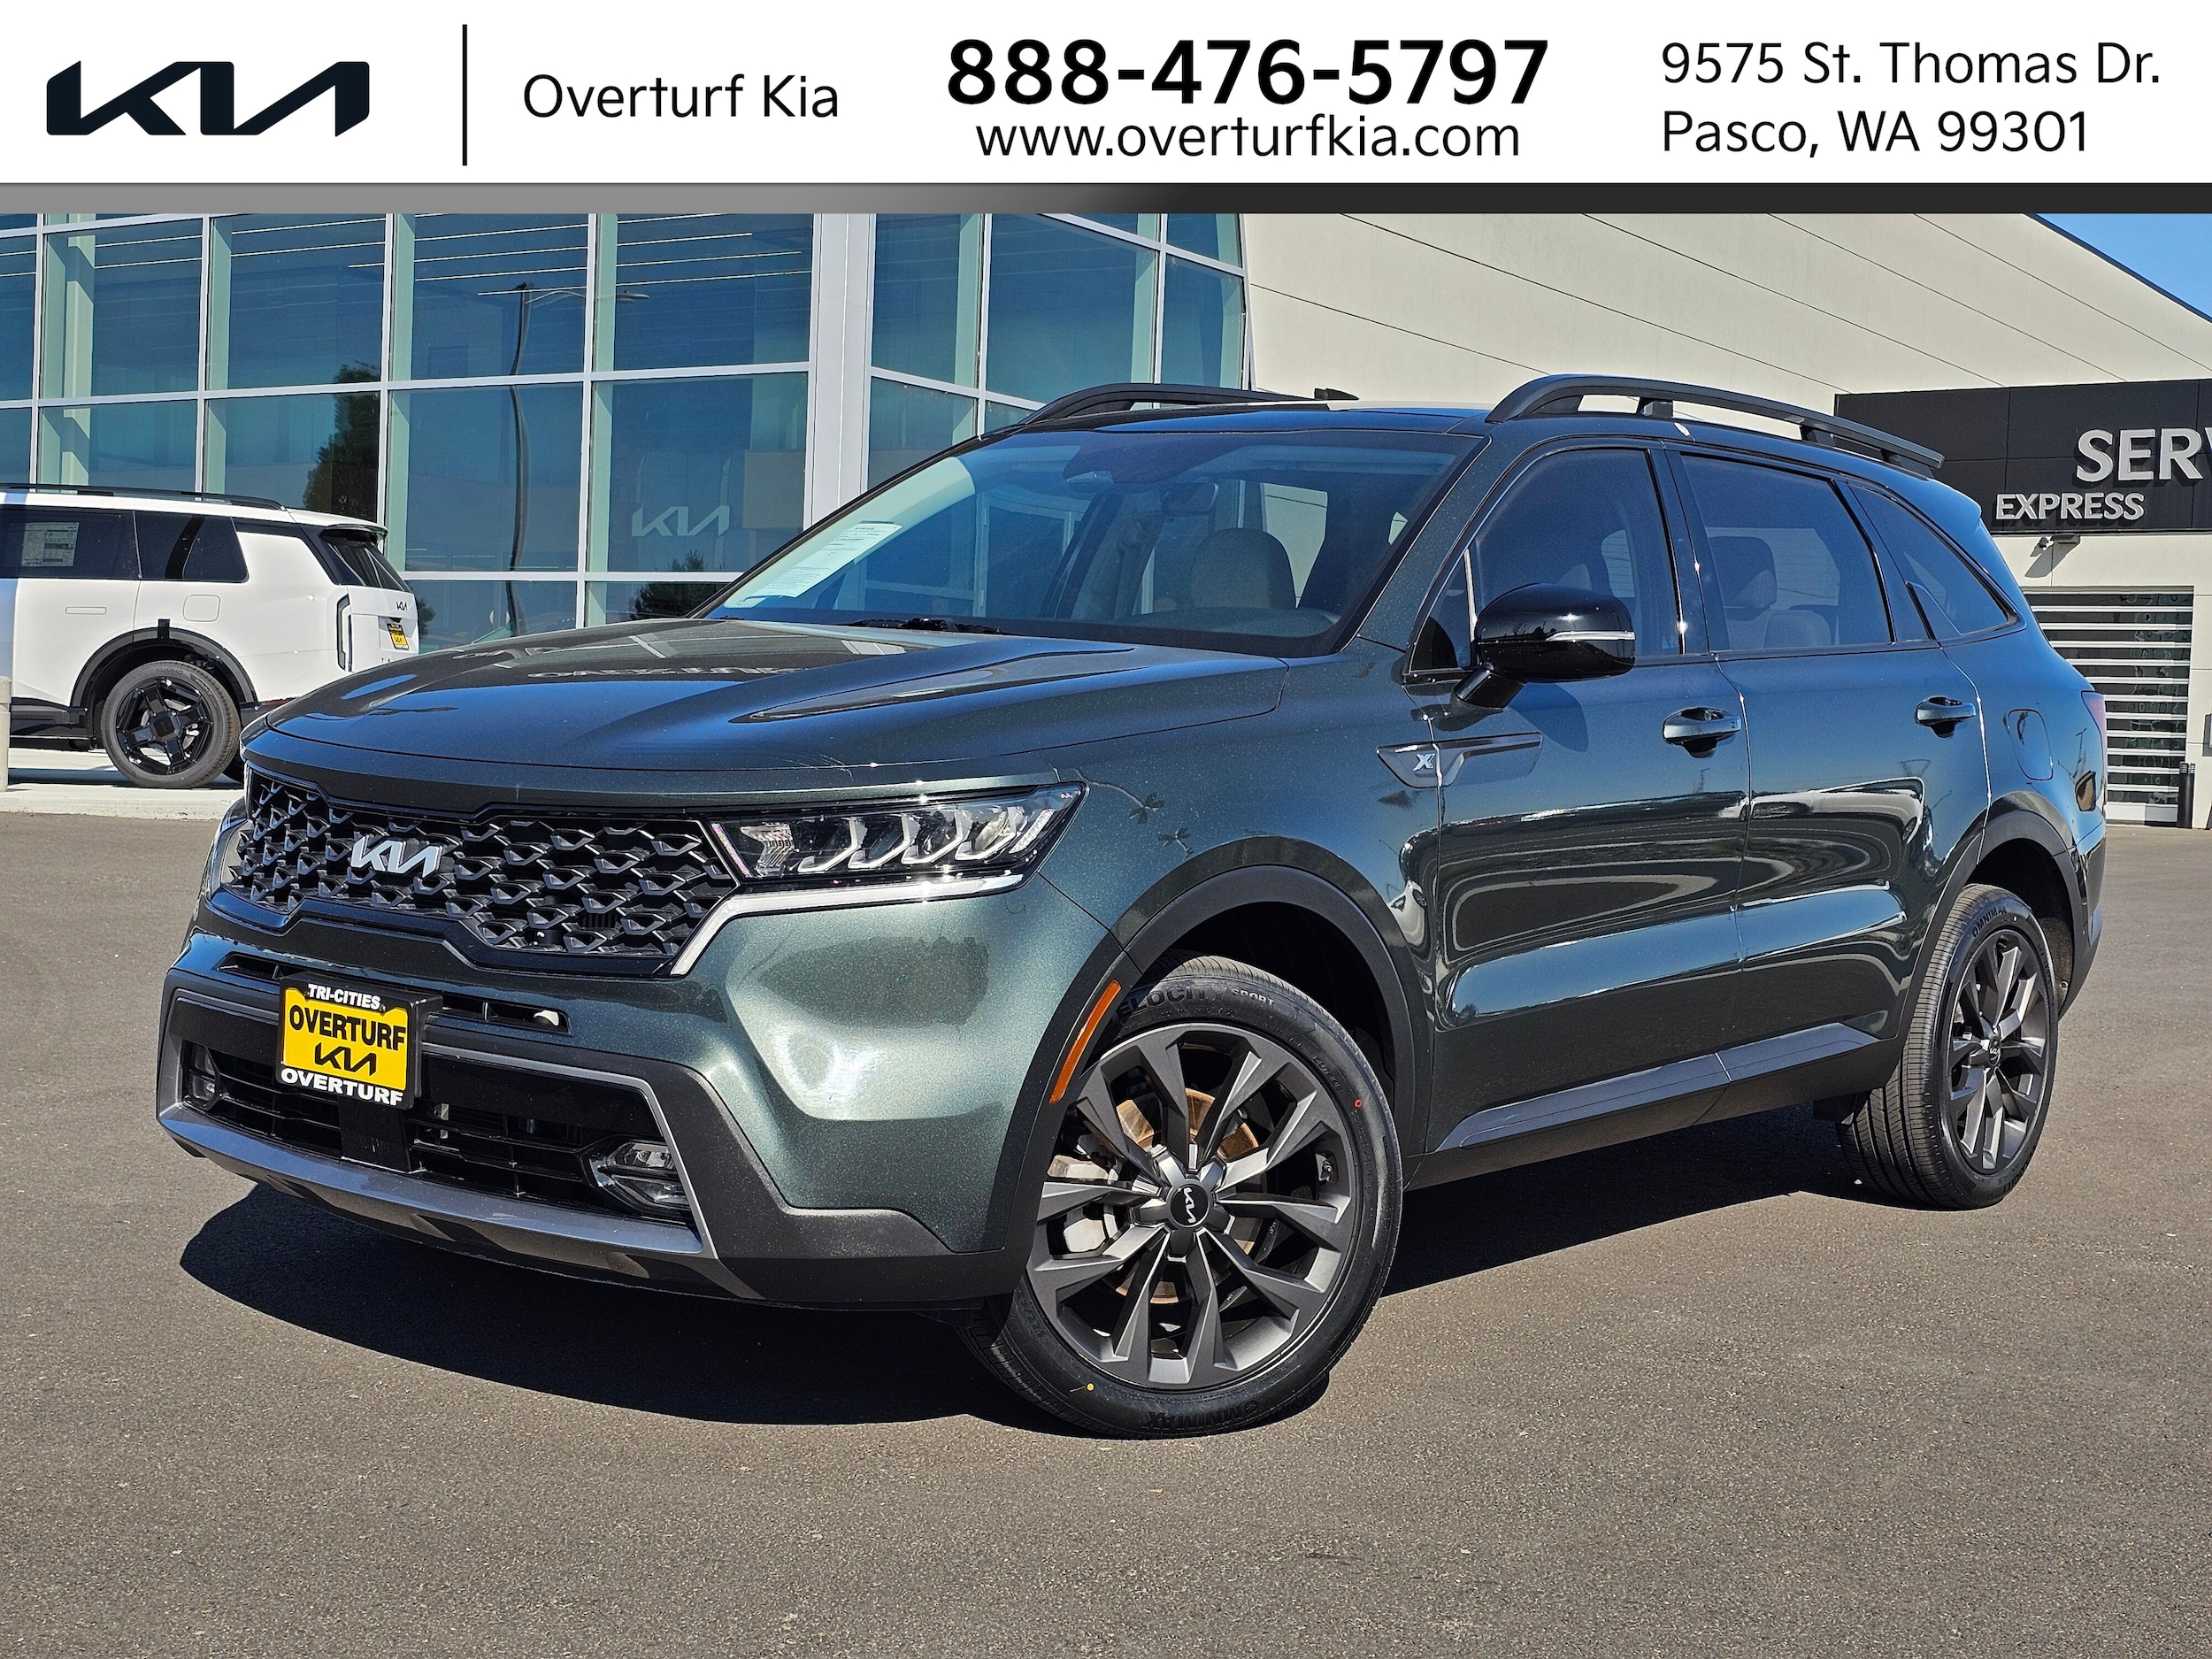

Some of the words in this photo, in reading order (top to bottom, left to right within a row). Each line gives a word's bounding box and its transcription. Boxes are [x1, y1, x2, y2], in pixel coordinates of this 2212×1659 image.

[2077, 427, 2212, 482] SER
[632, 505, 730, 537] KIA
[1996, 492, 2145, 520] EXPRESS
[396, 601, 408, 611] KIA
[156, 667, 184, 676] KUMHO
[350, 835, 442, 879] KIA
[1972, 906, 2008, 938] OMNIMAX
[308, 983, 381, 1010] TRI-CITIES
[1110, 985, 1228, 1020] ELOCITY
[1232, 987, 1276, 1007] SPORT
[289, 1004, 407, 1051] OVERTURF
[314, 1041, 377, 1077] KIA
[280, 1068, 404, 1107] OVERTURF
[1183, 1187, 1197, 1224] KIA
